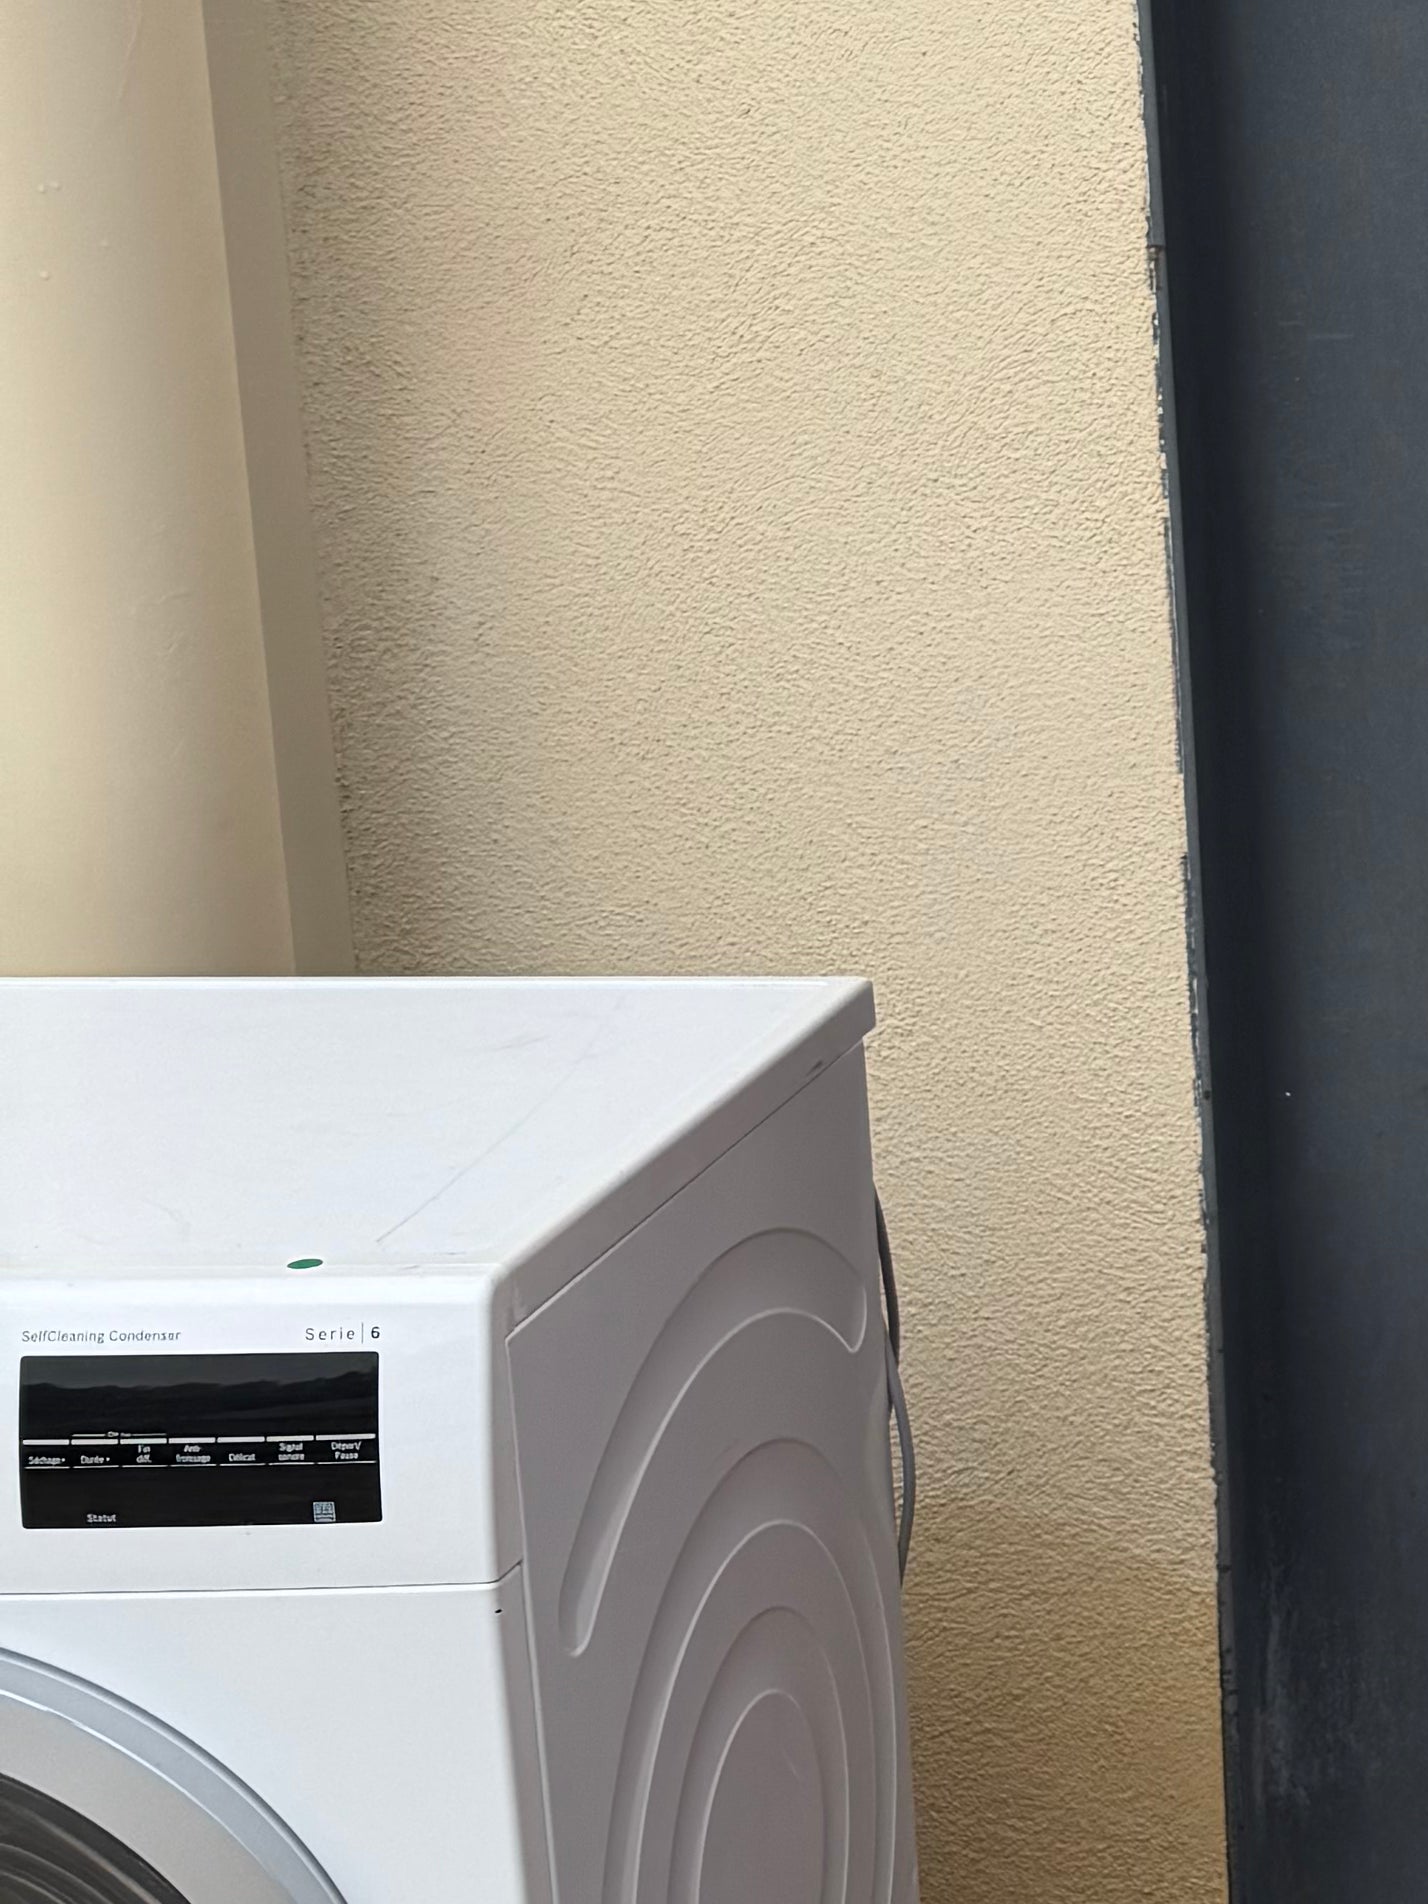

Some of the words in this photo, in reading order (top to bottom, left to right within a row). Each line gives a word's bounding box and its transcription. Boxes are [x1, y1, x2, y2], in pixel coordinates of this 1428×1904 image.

[21, 1329, 105, 1344] SelfCleaning
[109, 1329, 182, 1342] Condenser
[305, 1326, 355, 1341] Serie
[370, 1325, 381, 1339] 6
